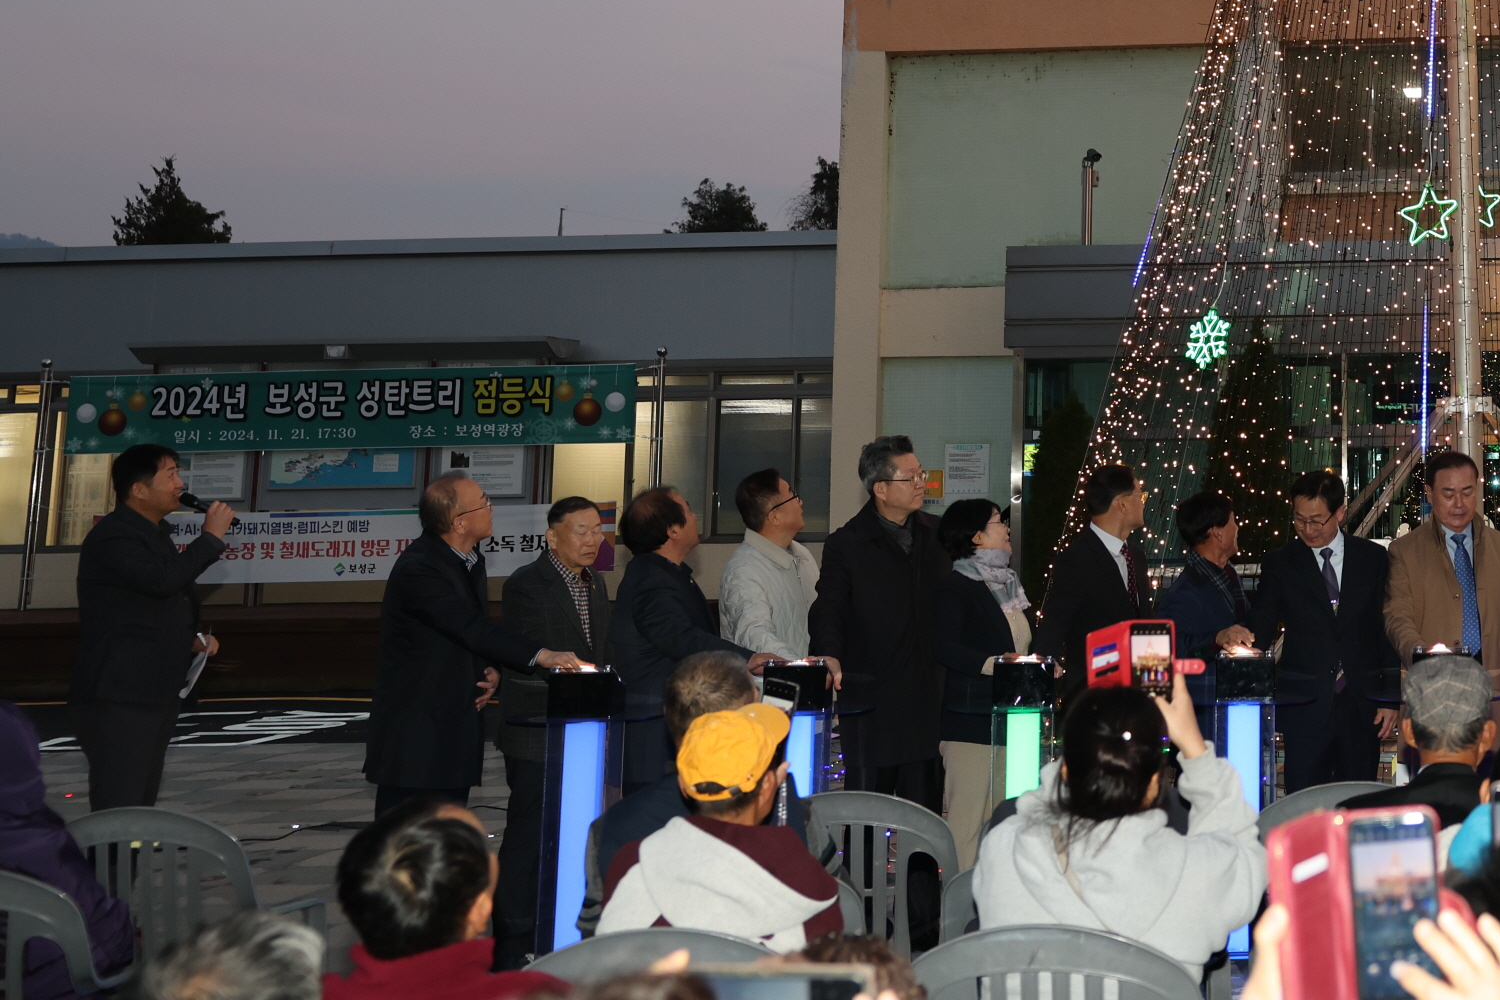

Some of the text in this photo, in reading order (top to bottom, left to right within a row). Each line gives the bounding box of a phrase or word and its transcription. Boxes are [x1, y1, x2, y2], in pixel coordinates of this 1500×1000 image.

[151, 377, 553, 420] 2024년 보성군 성탄트리 점등식
[174, 430, 200, 444] 일시
[219, 430, 260, 441] 2024.
[268, 429, 283, 441] 11.
[291, 428, 309, 440] 21.
[317, 427, 356, 439] 17:30
[409, 425, 436, 439] 장소
[455, 423, 524, 438] 보성역광장
[347, 519, 370, 533] 예방
[260, 542, 275, 560] 및
[279, 540, 356, 560] 철새도래지
[361, 539, 391, 558] 방문
[485, 535, 515, 553] 소독
[348, 563, 377, 574] 보성군
